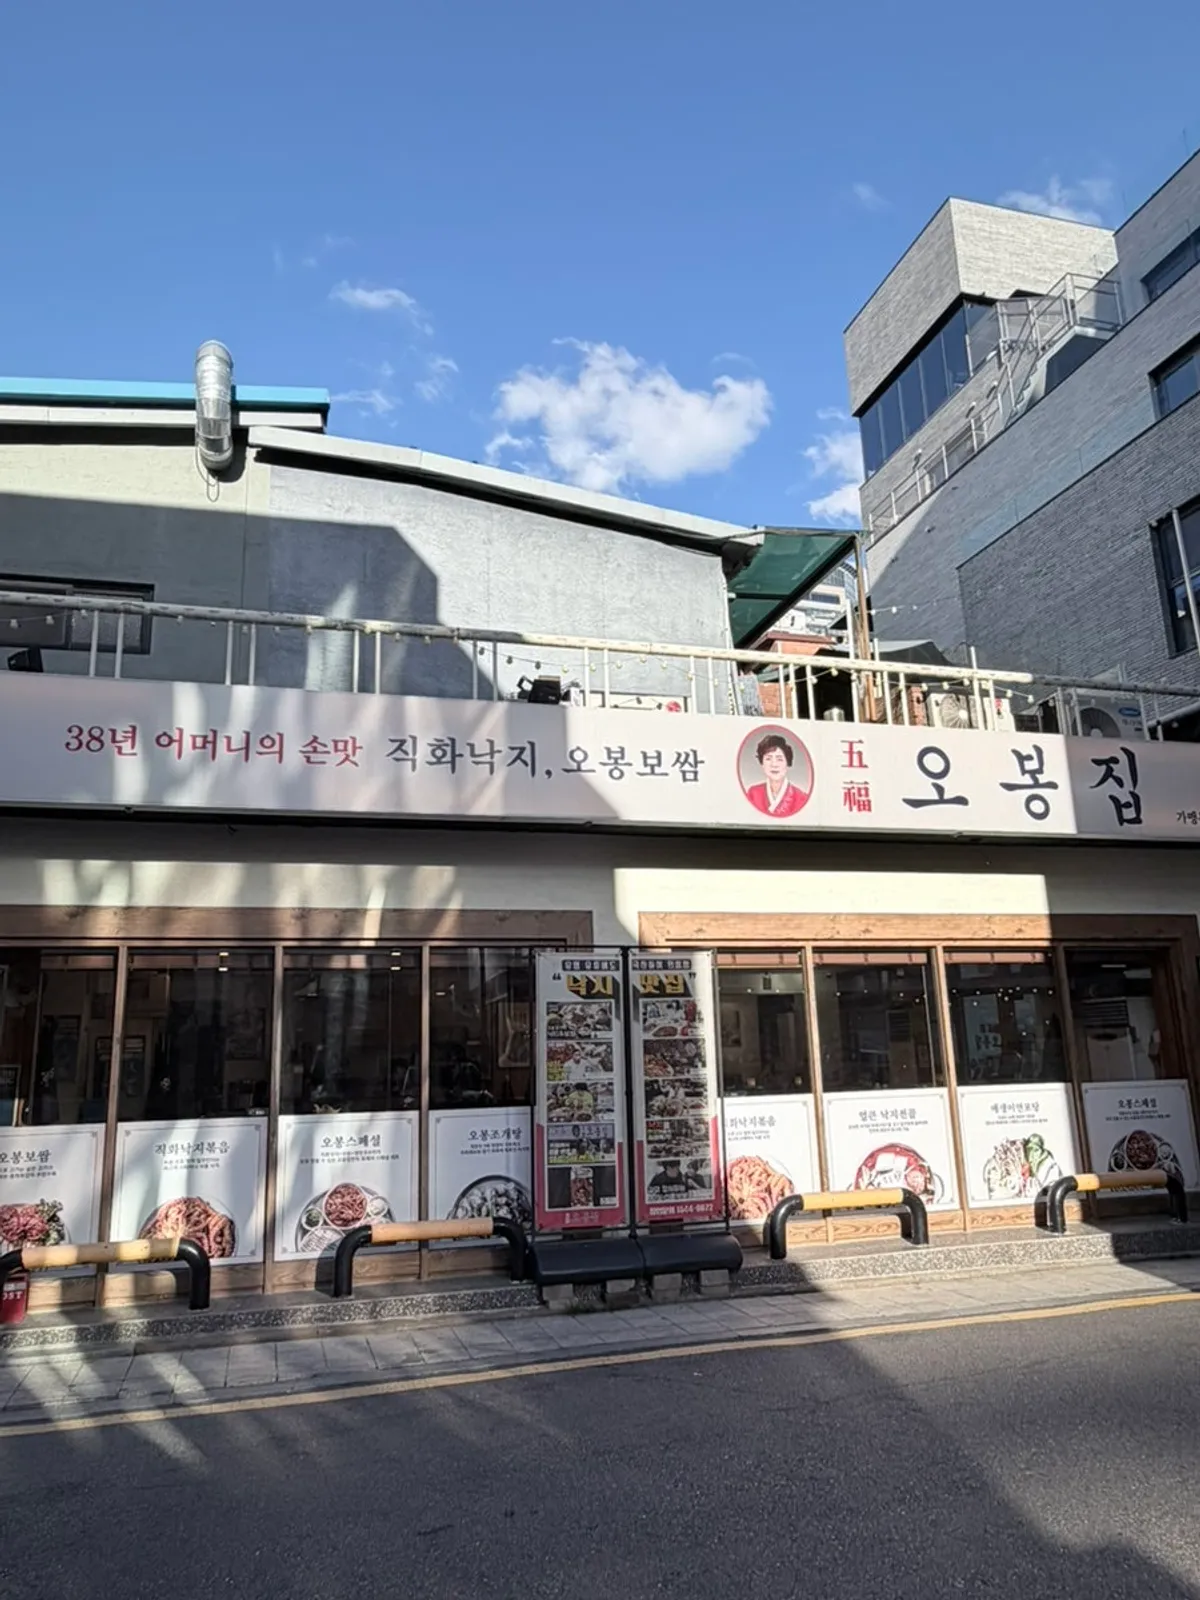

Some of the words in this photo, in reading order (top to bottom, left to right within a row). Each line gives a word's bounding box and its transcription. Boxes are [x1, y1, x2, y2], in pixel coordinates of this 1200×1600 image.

[64, 723, 138, 758] 38년
[154, 727, 285, 765] 어머니의
[298, 733, 364, 768] 손맛
[385, 734, 553, 779] 직화낙지,
[561, 745, 705, 783] 오봉보쌈
[840, 739, 873, 813] 五福
[902, 745, 1143, 826] 오봉집
[154, 1140, 230, 1156] 직화낙지볶음
[320, 1133, 381, 1149] 오봉스페셜
[467, 1126, 523, 1142] 오봉조개탕
